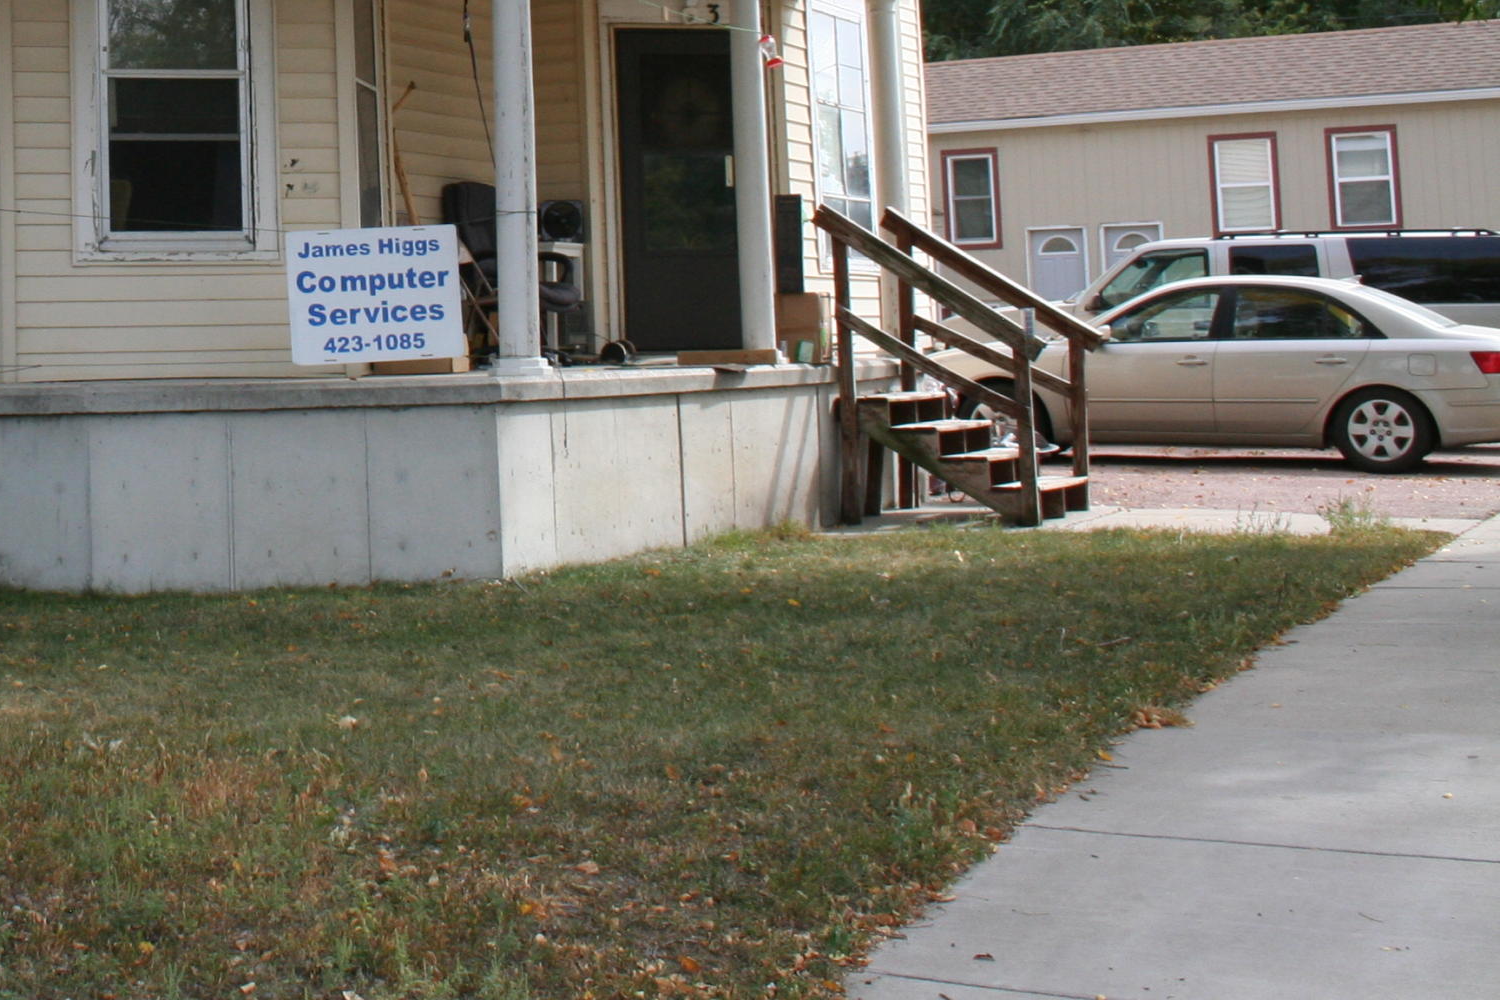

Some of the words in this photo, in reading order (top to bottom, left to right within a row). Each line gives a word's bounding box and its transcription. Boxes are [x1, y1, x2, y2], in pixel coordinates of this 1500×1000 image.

[707, 4, 720, 24] 3
[297, 242, 371, 259] James
[378, 237, 441, 257] Higgs
[296, 267, 450, 296] Computer
[308, 300, 445, 327] Services
[323, 332, 426, 353] 423-1085
